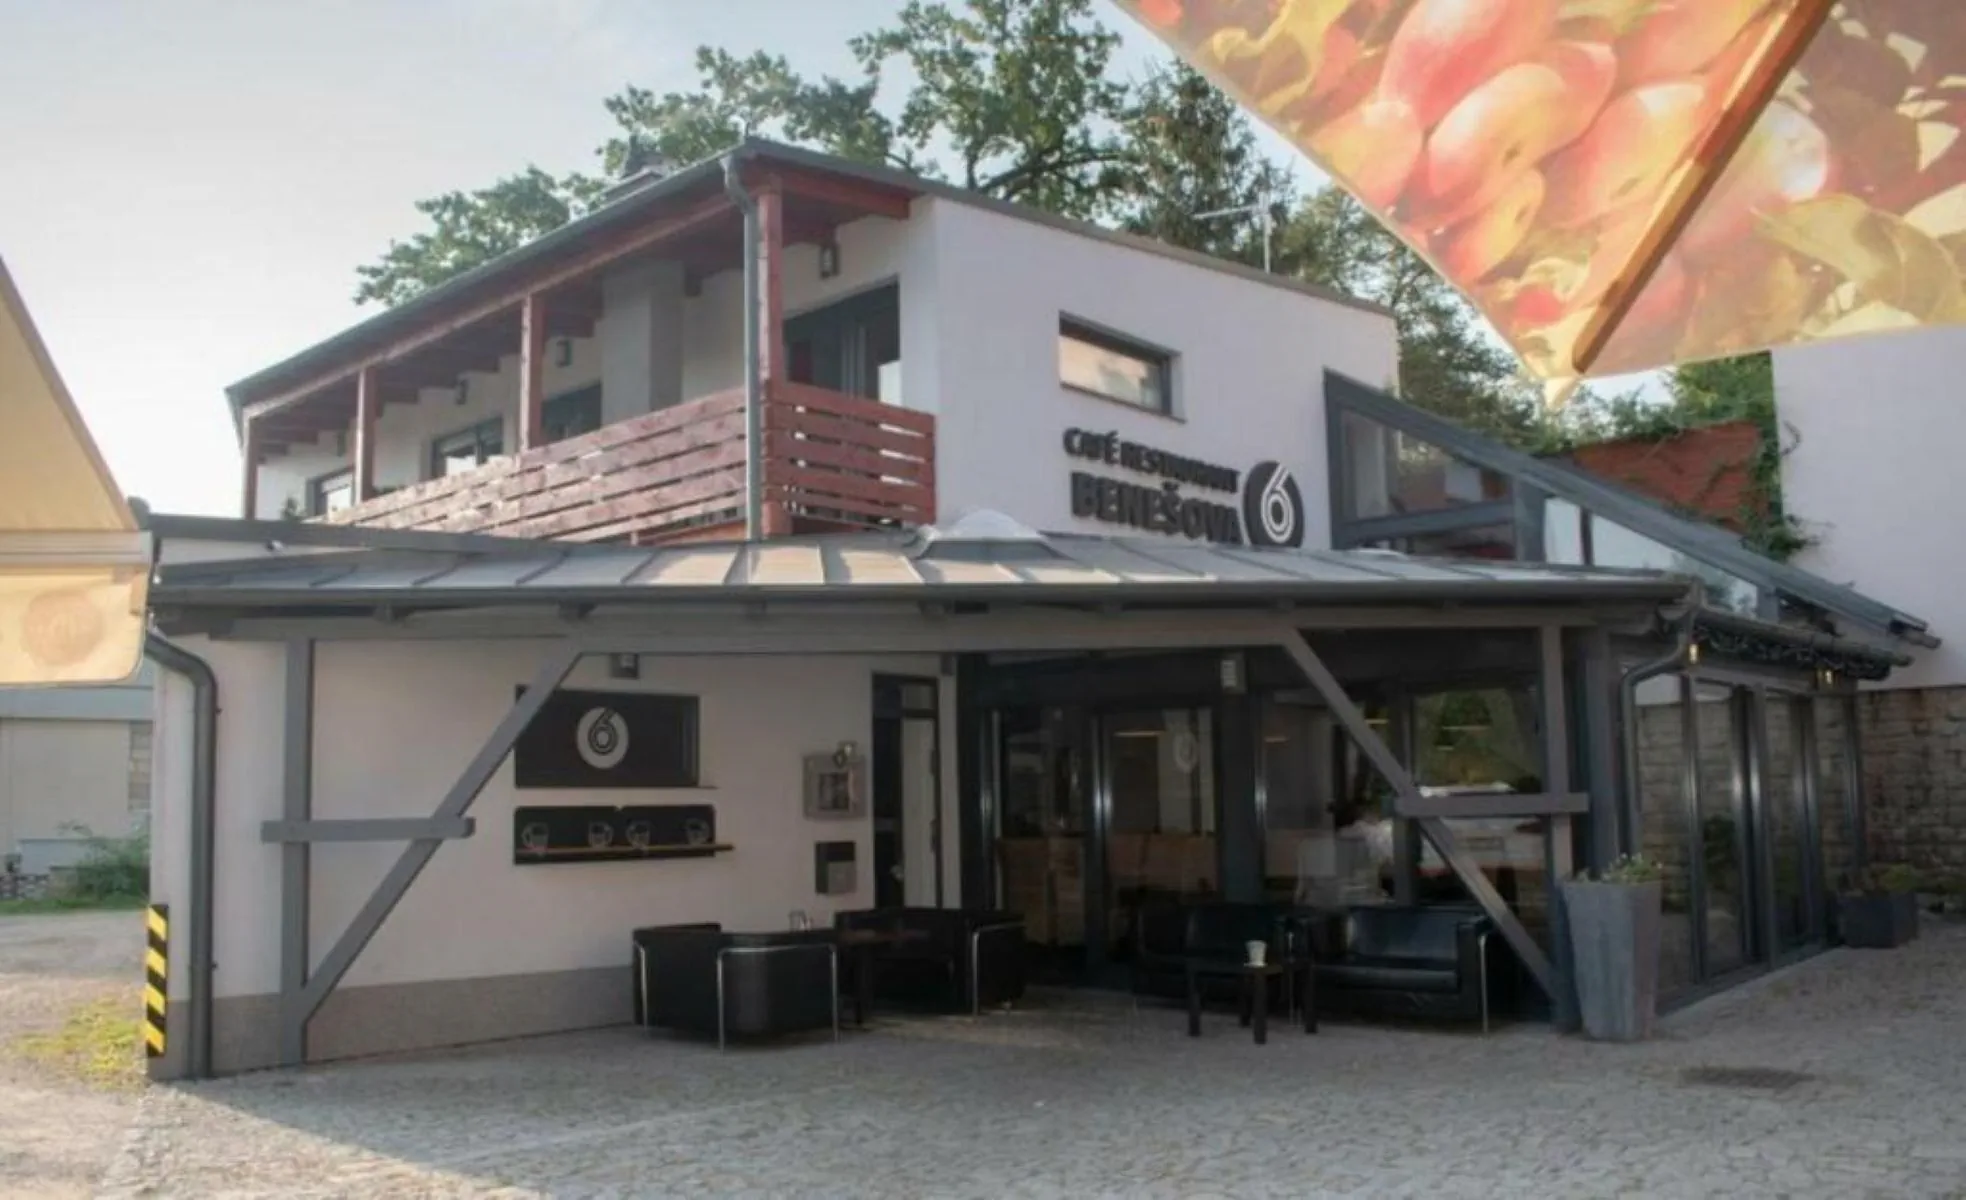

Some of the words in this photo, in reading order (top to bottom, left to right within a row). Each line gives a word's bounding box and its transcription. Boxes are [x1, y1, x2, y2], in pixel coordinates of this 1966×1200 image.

[1063, 427, 1121, 464] CAFÉ
[1070, 470, 1244, 545] BENEŠOVA
[1259, 461, 1296, 545] 6
